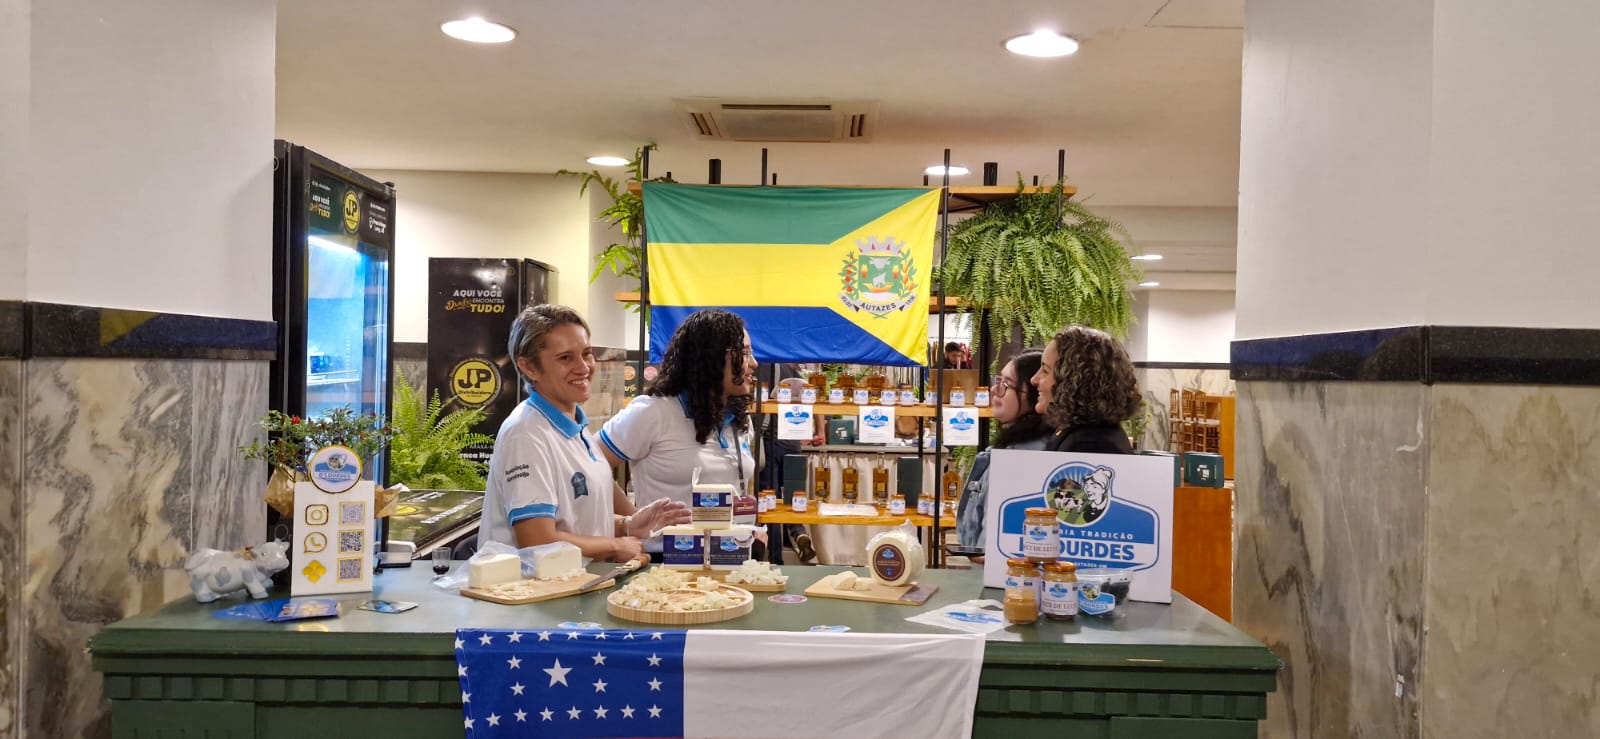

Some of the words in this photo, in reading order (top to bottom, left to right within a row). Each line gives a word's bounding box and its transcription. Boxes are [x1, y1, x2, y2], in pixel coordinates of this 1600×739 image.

[345, 199, 358, 217] JP
[453, 290, 475, 298] AQUI
[477, 287, 503, 298] VOCÊ
[470, 304, 505, 313] TUDO!
[860, 302, 896, 311] AUTAZES
[458, 368, 492, 389] JP
[1081, 529, 1134, 540] TRADIÇÃO
